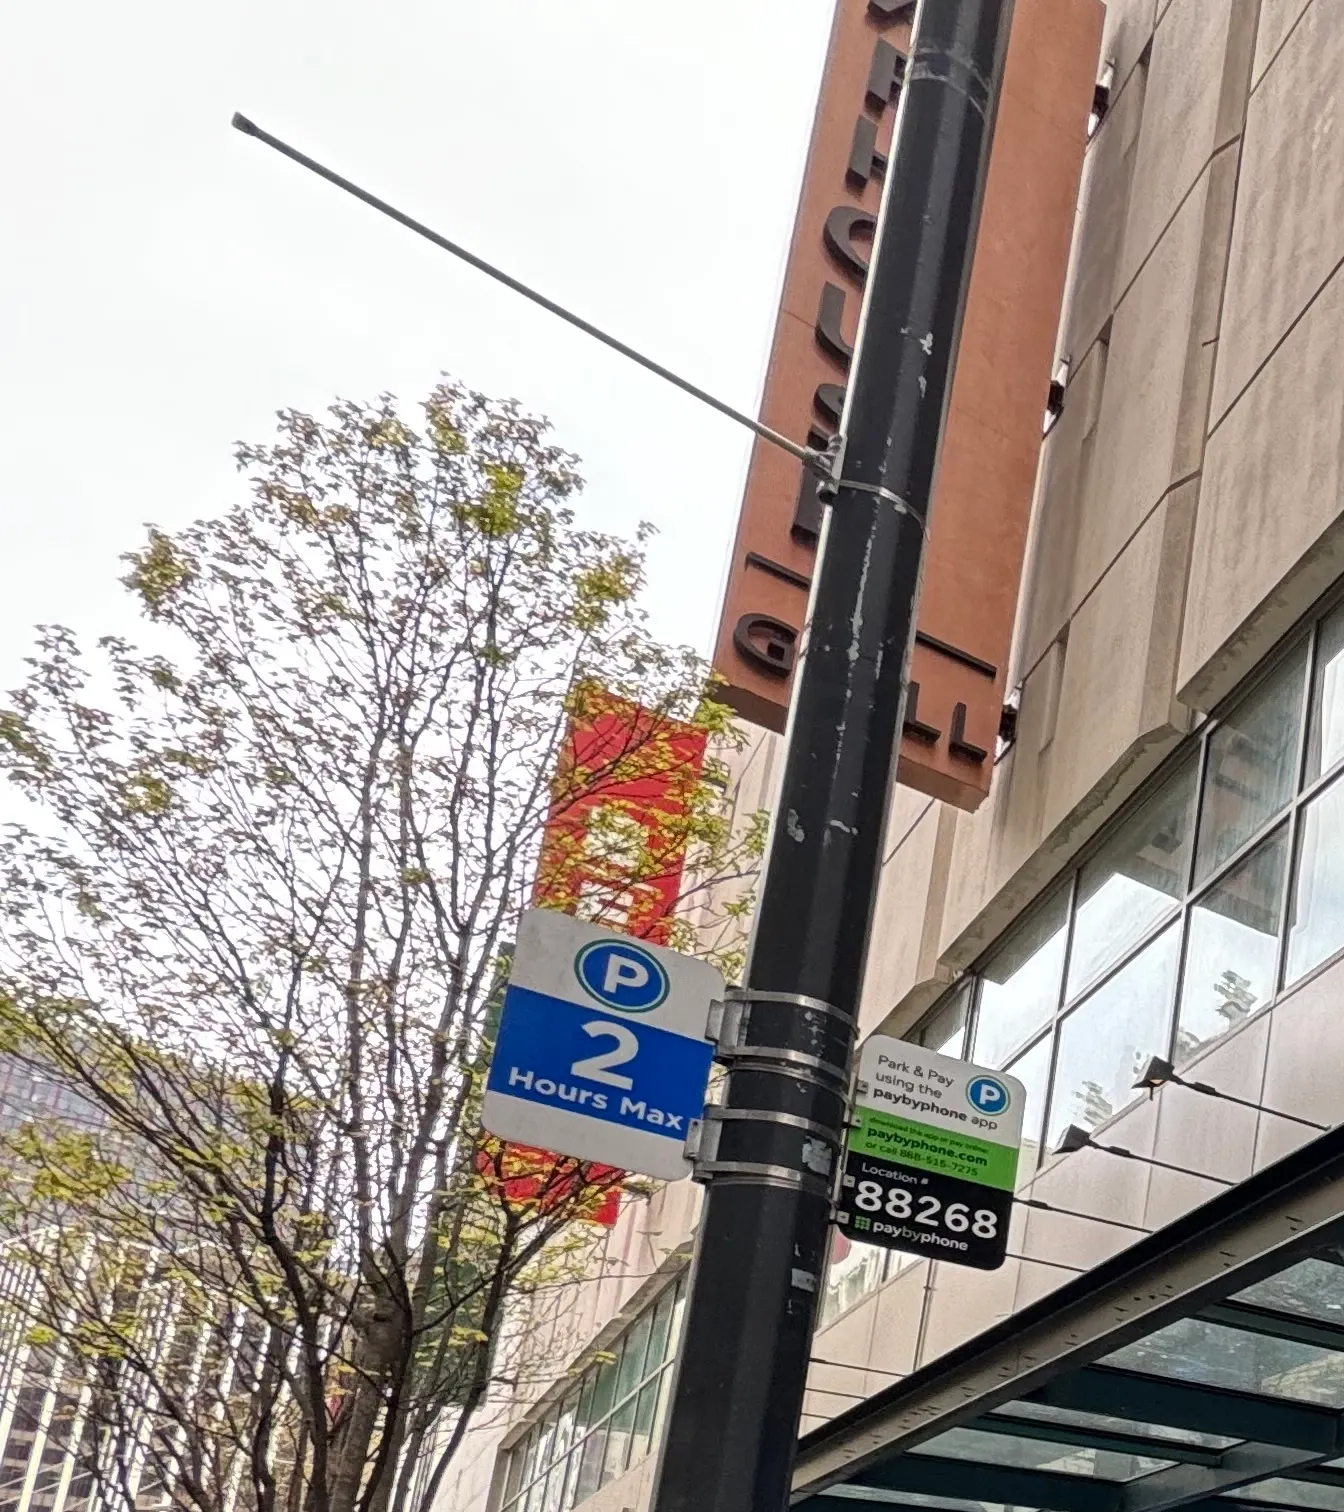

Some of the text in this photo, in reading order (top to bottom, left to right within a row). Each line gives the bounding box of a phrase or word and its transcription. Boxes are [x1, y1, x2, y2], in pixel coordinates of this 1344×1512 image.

[733, 612, 988, 766] GLL
[604, 953, 650, 994] P
[570, 1020, 640, 1091] 2
[878, 1054, 955, 1088] Park & Pay
[508, 1066, 684, 1131] Hours Max
[875, 1071, 943, 1099] using the
[979, 1083, 1001, 1105] P
[873, 1087, 998, 1131] paybyphone app
[865, 1142, 876, 1150] or
[880, 1144, 898, 1155] call
[868, 1127, 988, 1166] paybyphone.com
[862, 1162, 918, 1184] Location
[855, 1180, 998, 1239] 88268
[873, 1221, 969, 1251] paybyphone
